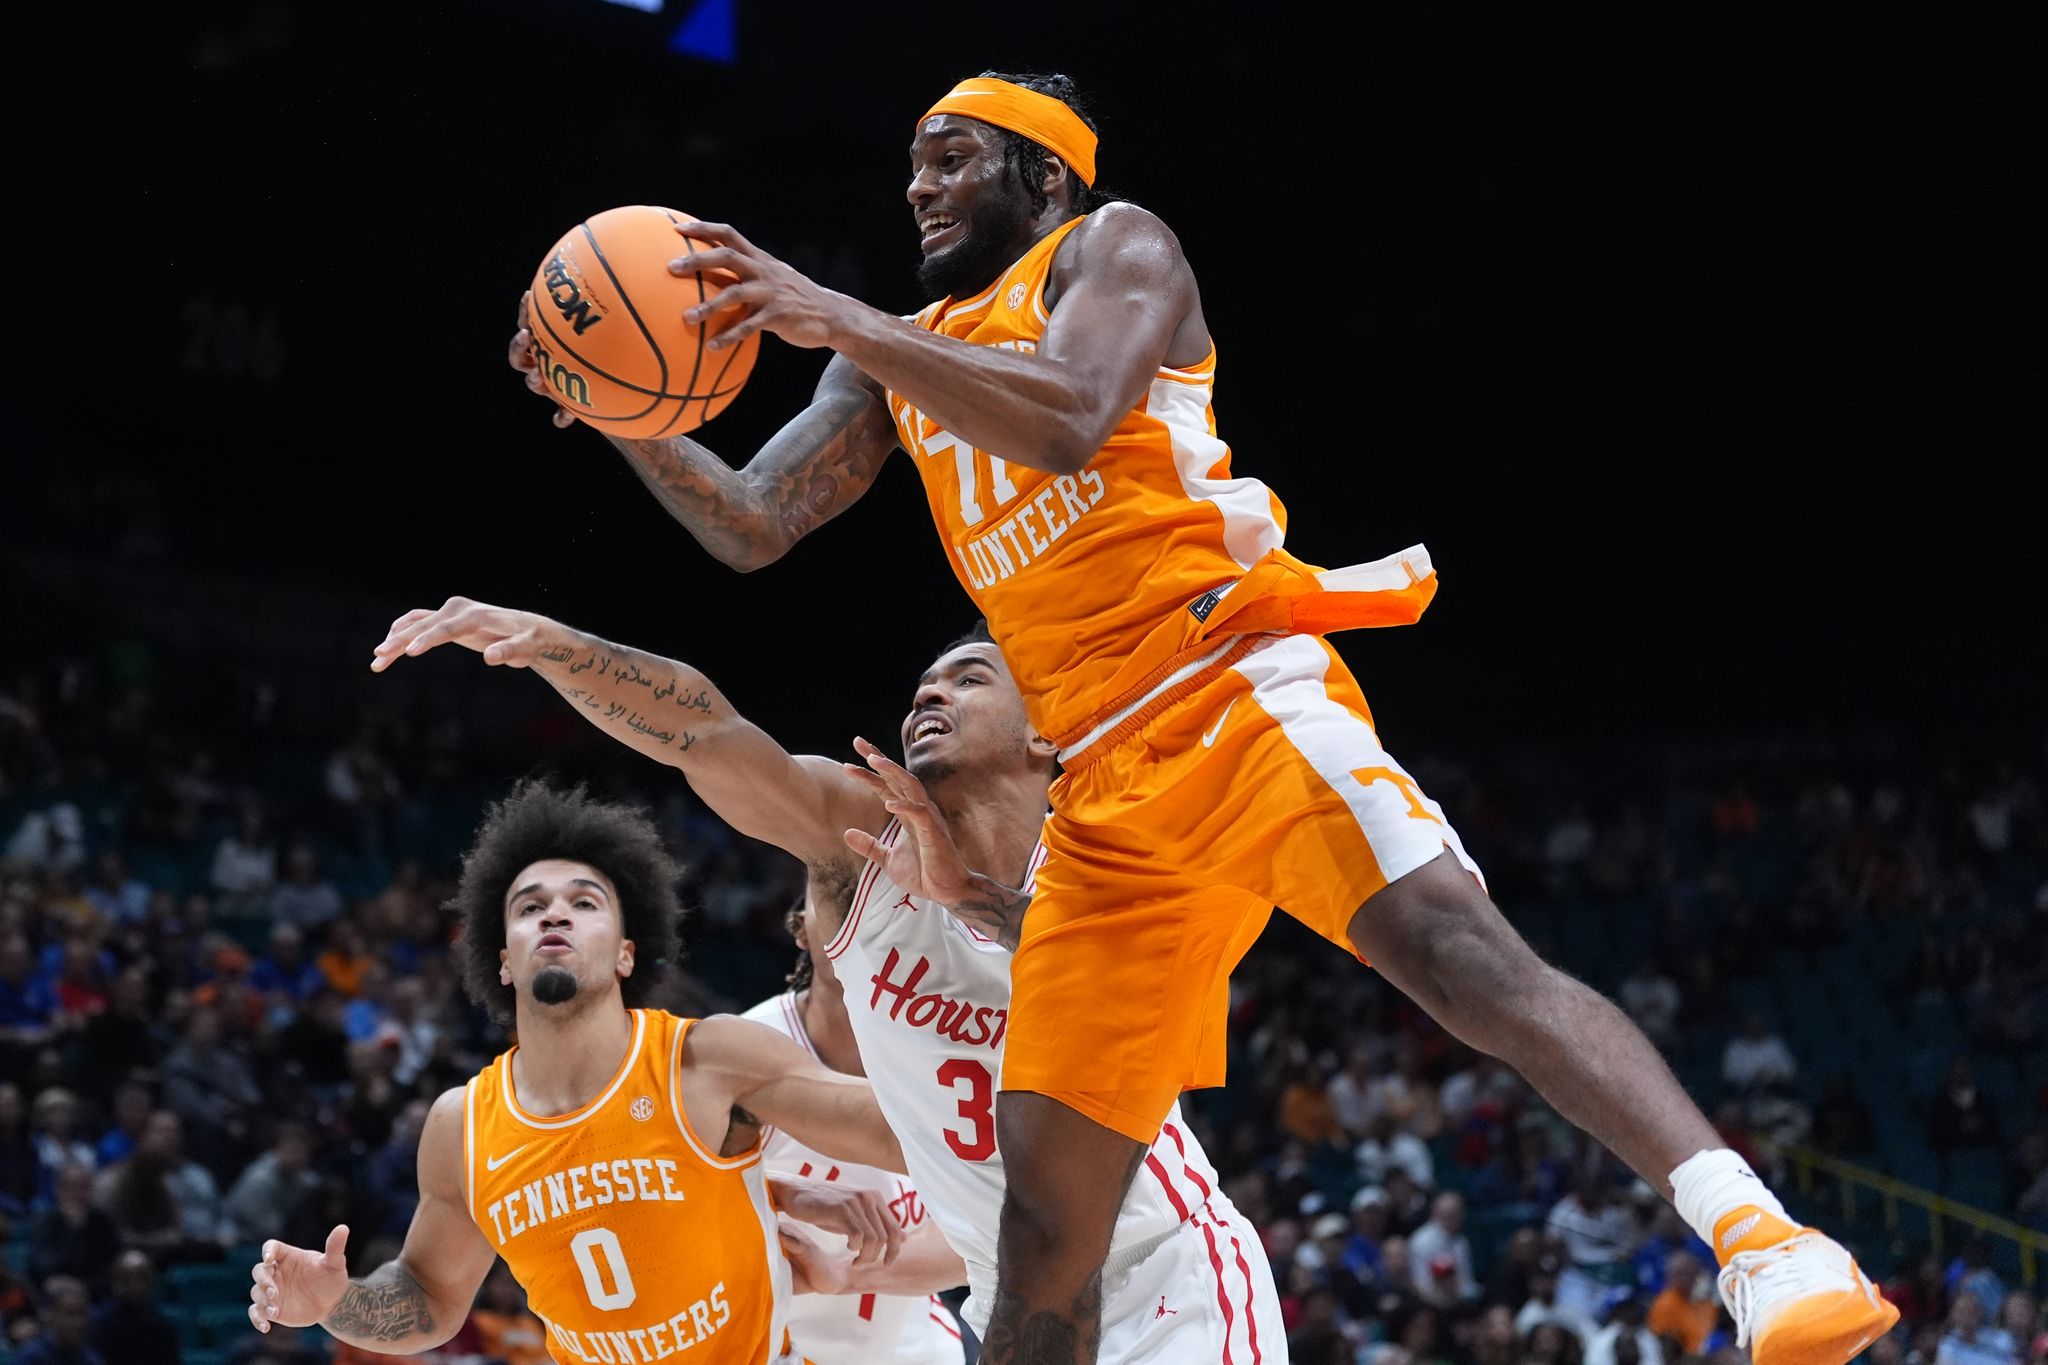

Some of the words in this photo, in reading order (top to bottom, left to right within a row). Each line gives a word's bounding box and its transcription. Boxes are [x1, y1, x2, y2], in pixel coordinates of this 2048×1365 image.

[1007, 285, 1026, 310] SEC
[953, 468, 1105, 591] LUNTEERS
[654, 678, 676, 700] في
[1348, 765, 1445, 828] T
[869, 945, 1008, 1051] Houst
[631, 1096, 654, 1121] SEC
[936, 1058, 997, 1162] 3
[487, 1158, 685, 1247] TENNESSEE
[569, 1226, 637, 1312] 0
[537, 1280, 732, 1365] OLUNTEERS
